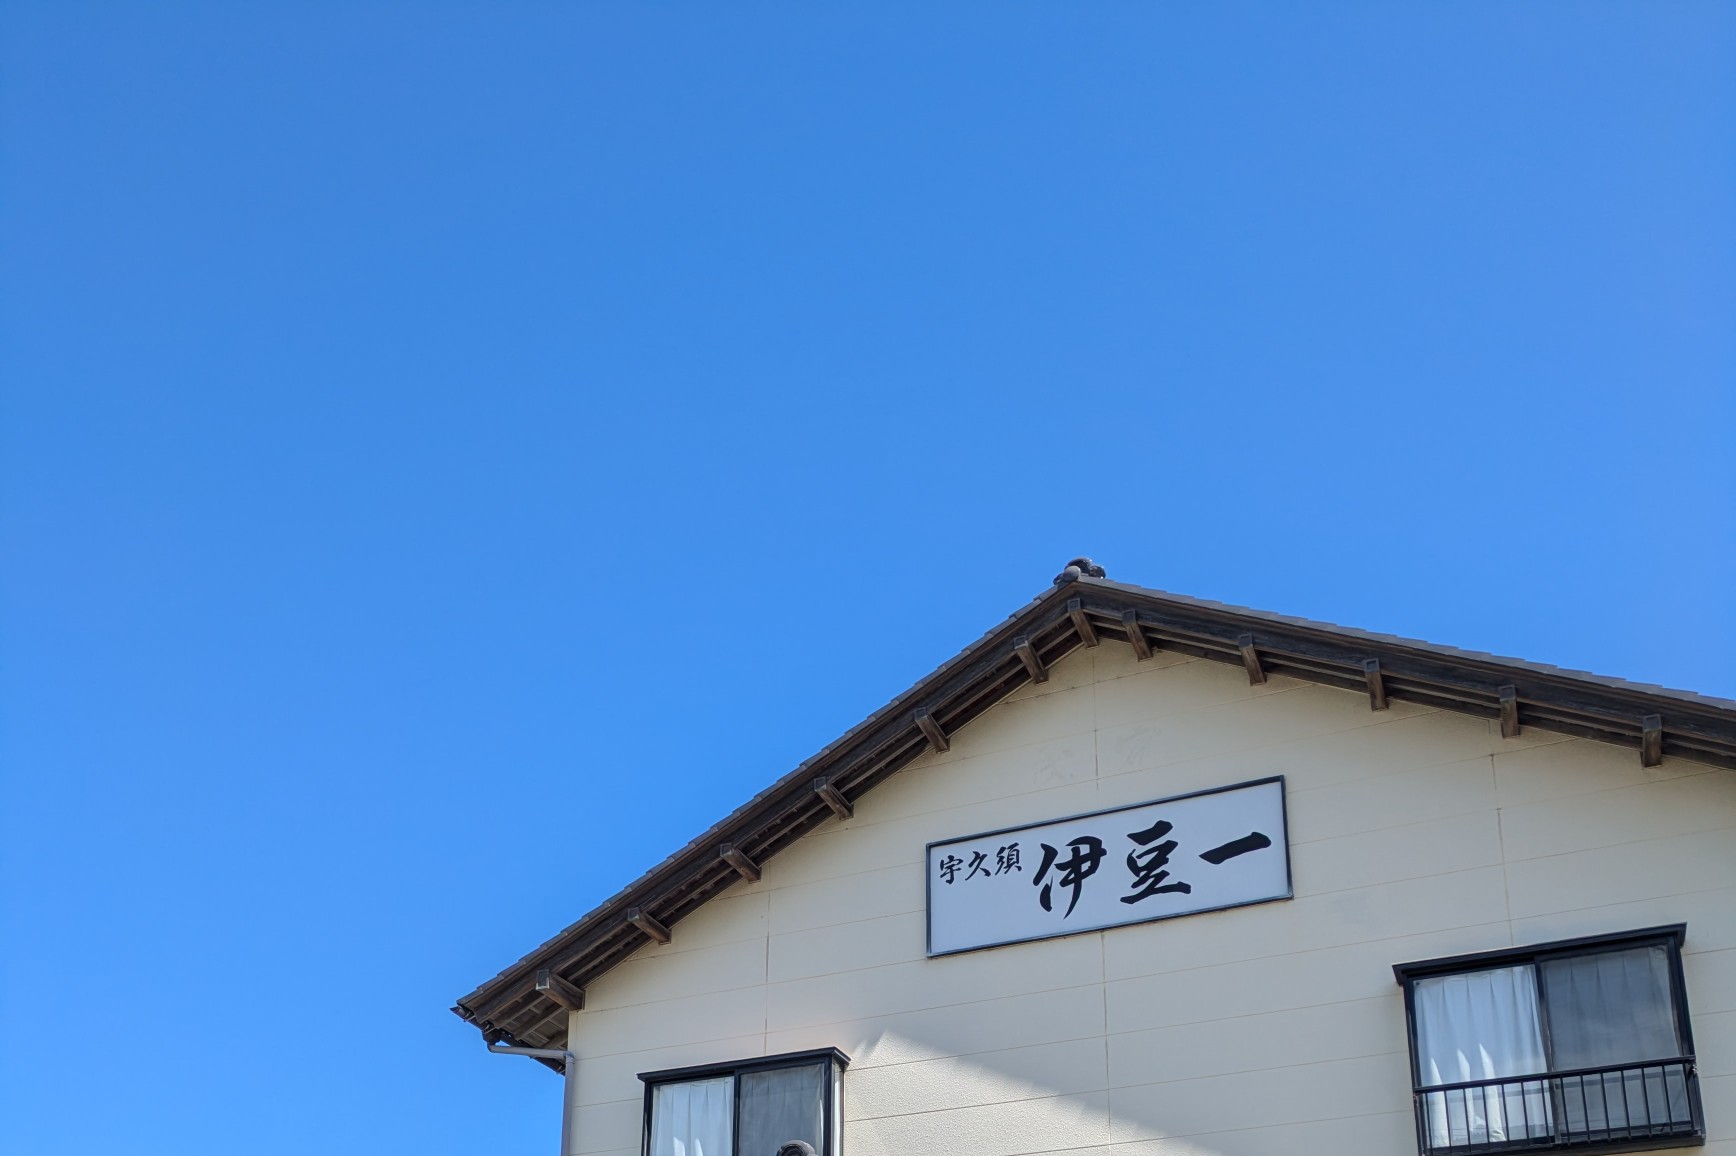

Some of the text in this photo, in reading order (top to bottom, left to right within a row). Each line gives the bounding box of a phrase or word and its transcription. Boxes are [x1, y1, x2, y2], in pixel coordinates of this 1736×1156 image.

[939, 819, 1272, 920] 宇久須 伊豆一
